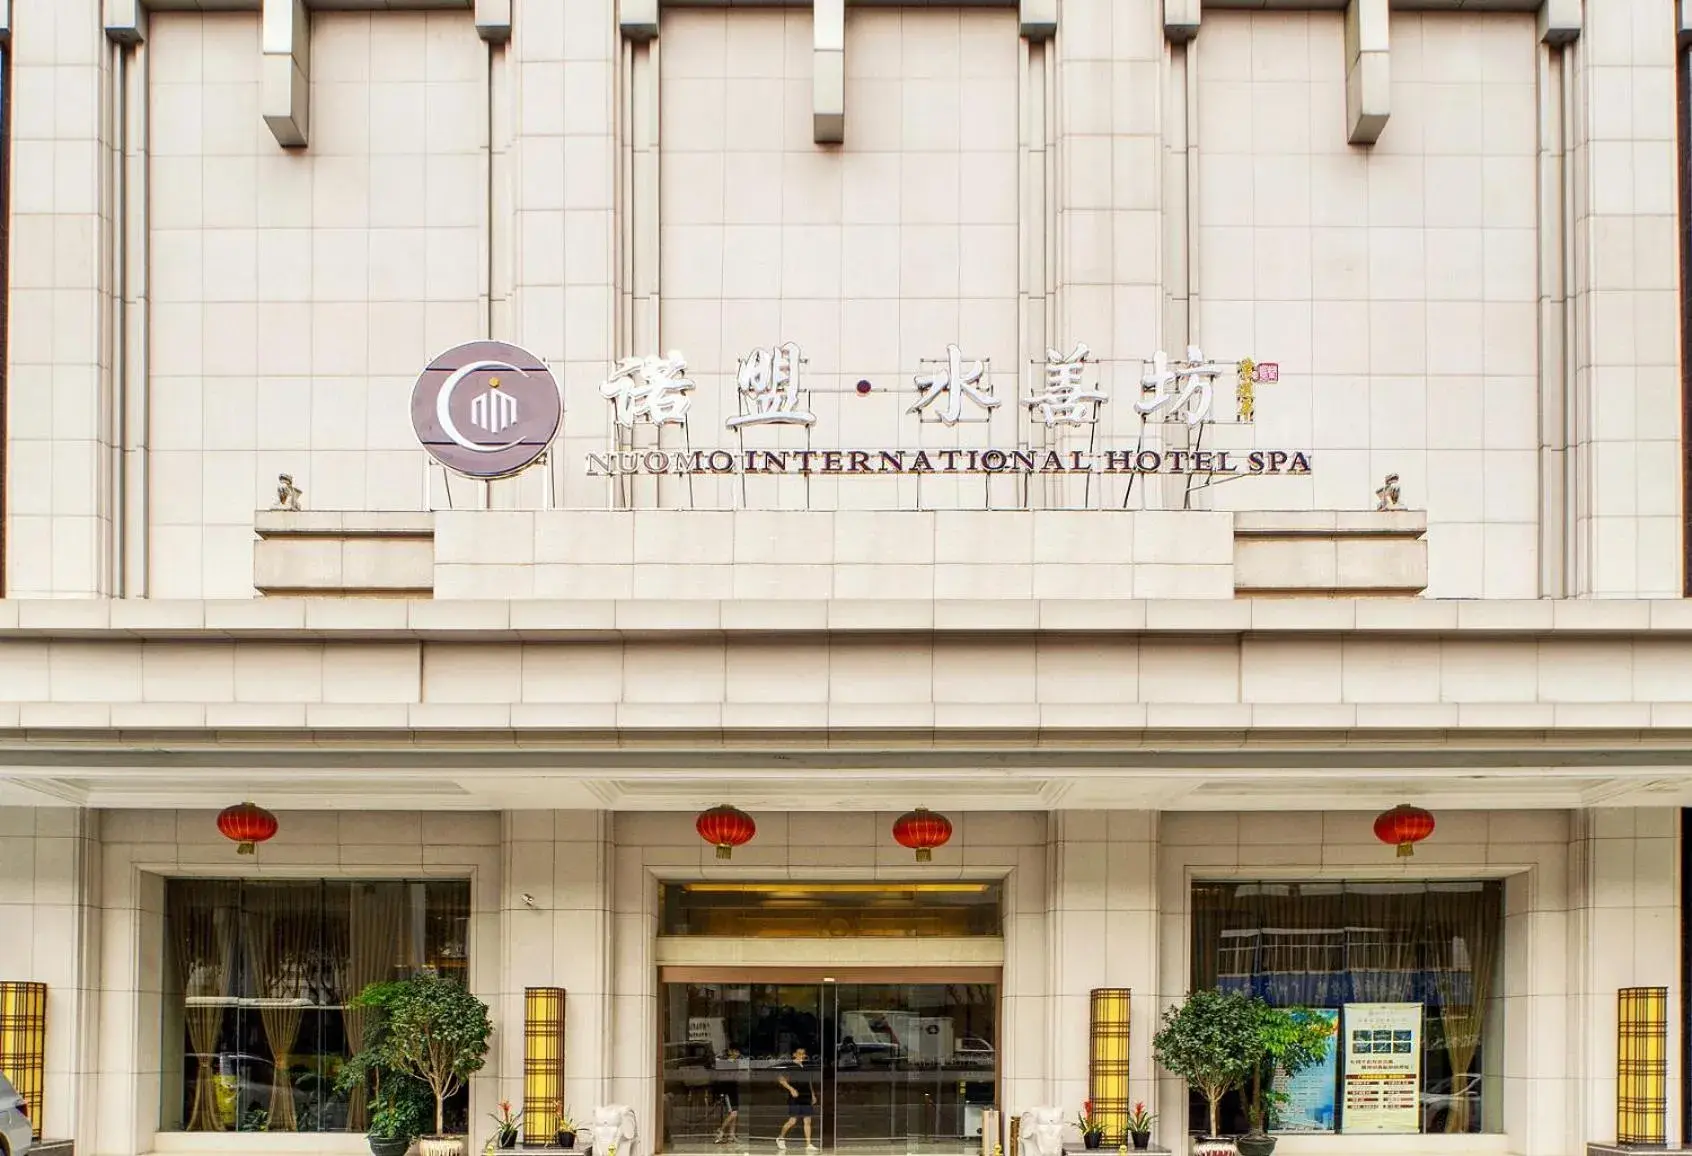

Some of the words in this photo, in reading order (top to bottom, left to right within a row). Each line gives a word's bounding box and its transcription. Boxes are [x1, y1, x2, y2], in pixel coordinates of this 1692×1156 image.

[585, 449, 736, 475] NUOMO
[744, 449, 1093, 474] INTERNATIONAL
[1102, 449, 1238, 474] HOTEL
[1248, 449, 1312, 474] SPA
